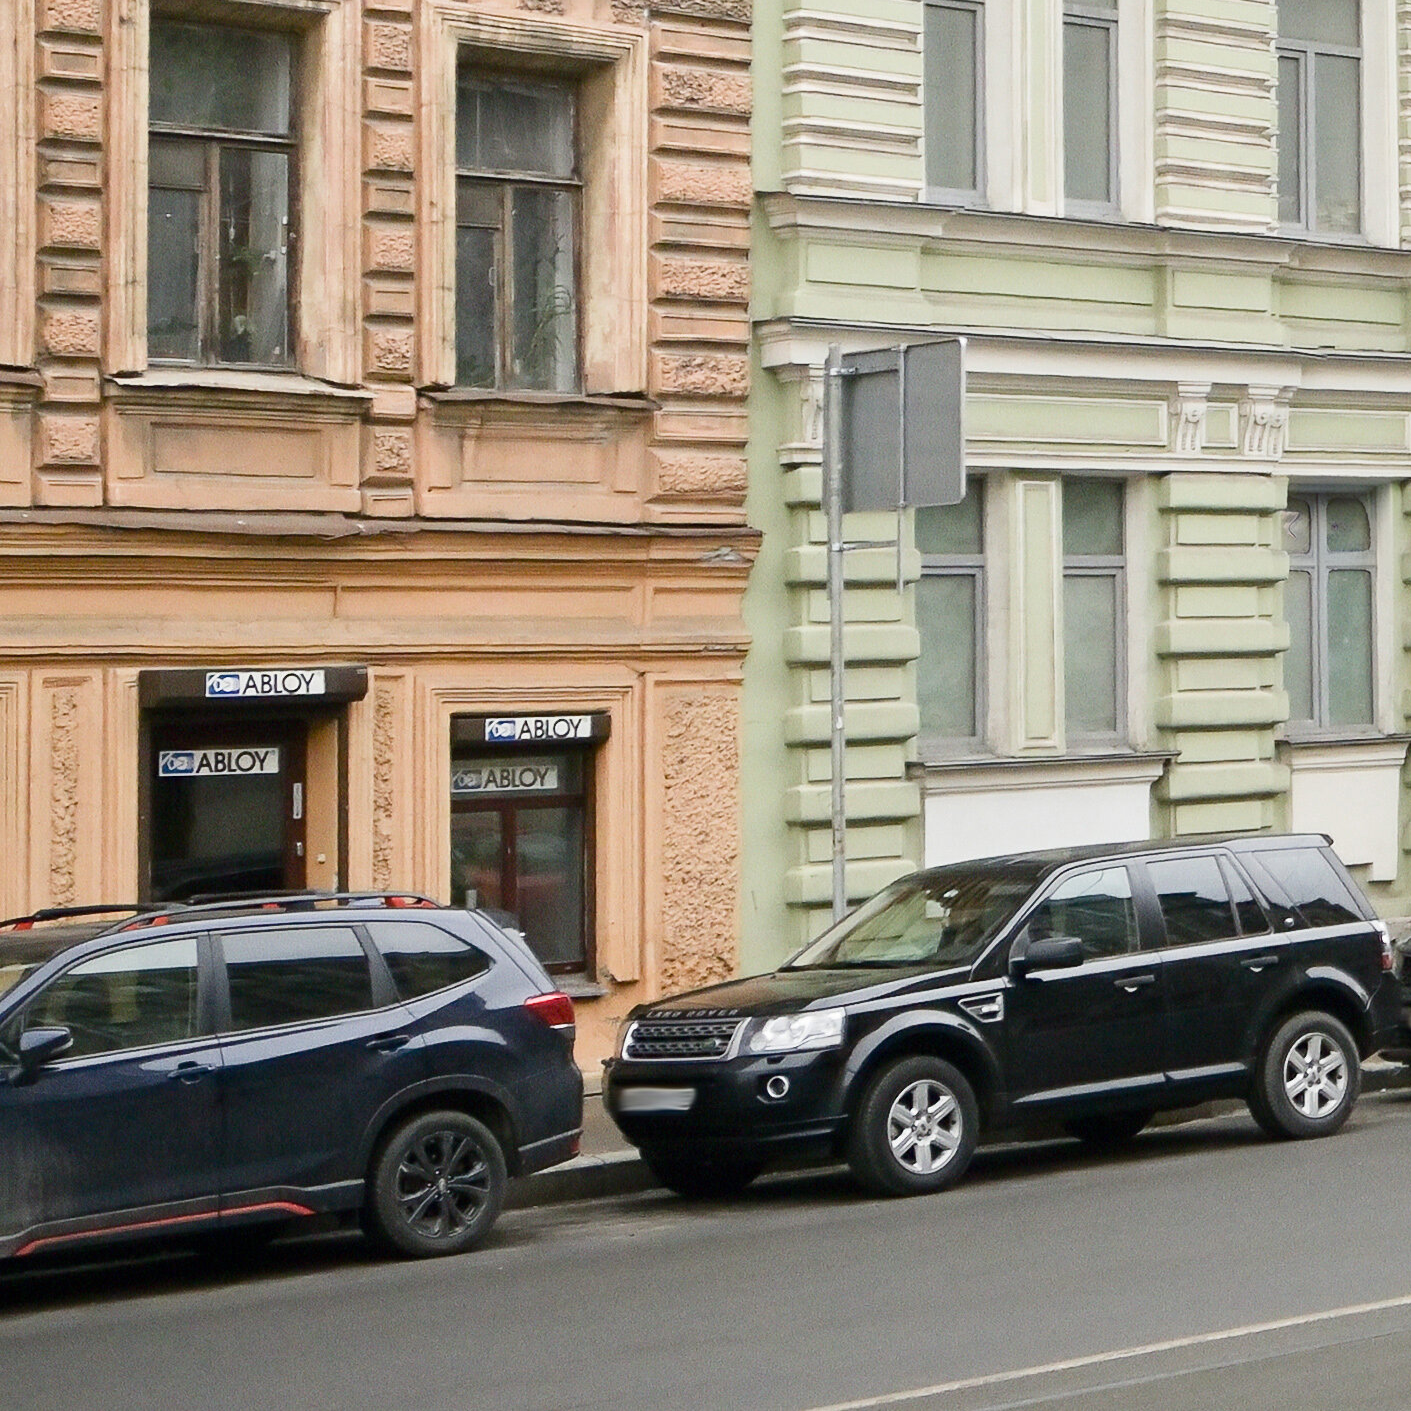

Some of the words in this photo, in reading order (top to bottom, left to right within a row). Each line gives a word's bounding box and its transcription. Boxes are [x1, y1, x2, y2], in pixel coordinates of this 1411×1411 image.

[242, 672, 315, 694] ABLOY
[517, 718, 582, 739] ABLOY
[195, 750, 270, 774] ABLOY
[483, 767, 550, 789] ABLOY
[686, 1009, 738, 1018] ROVER
